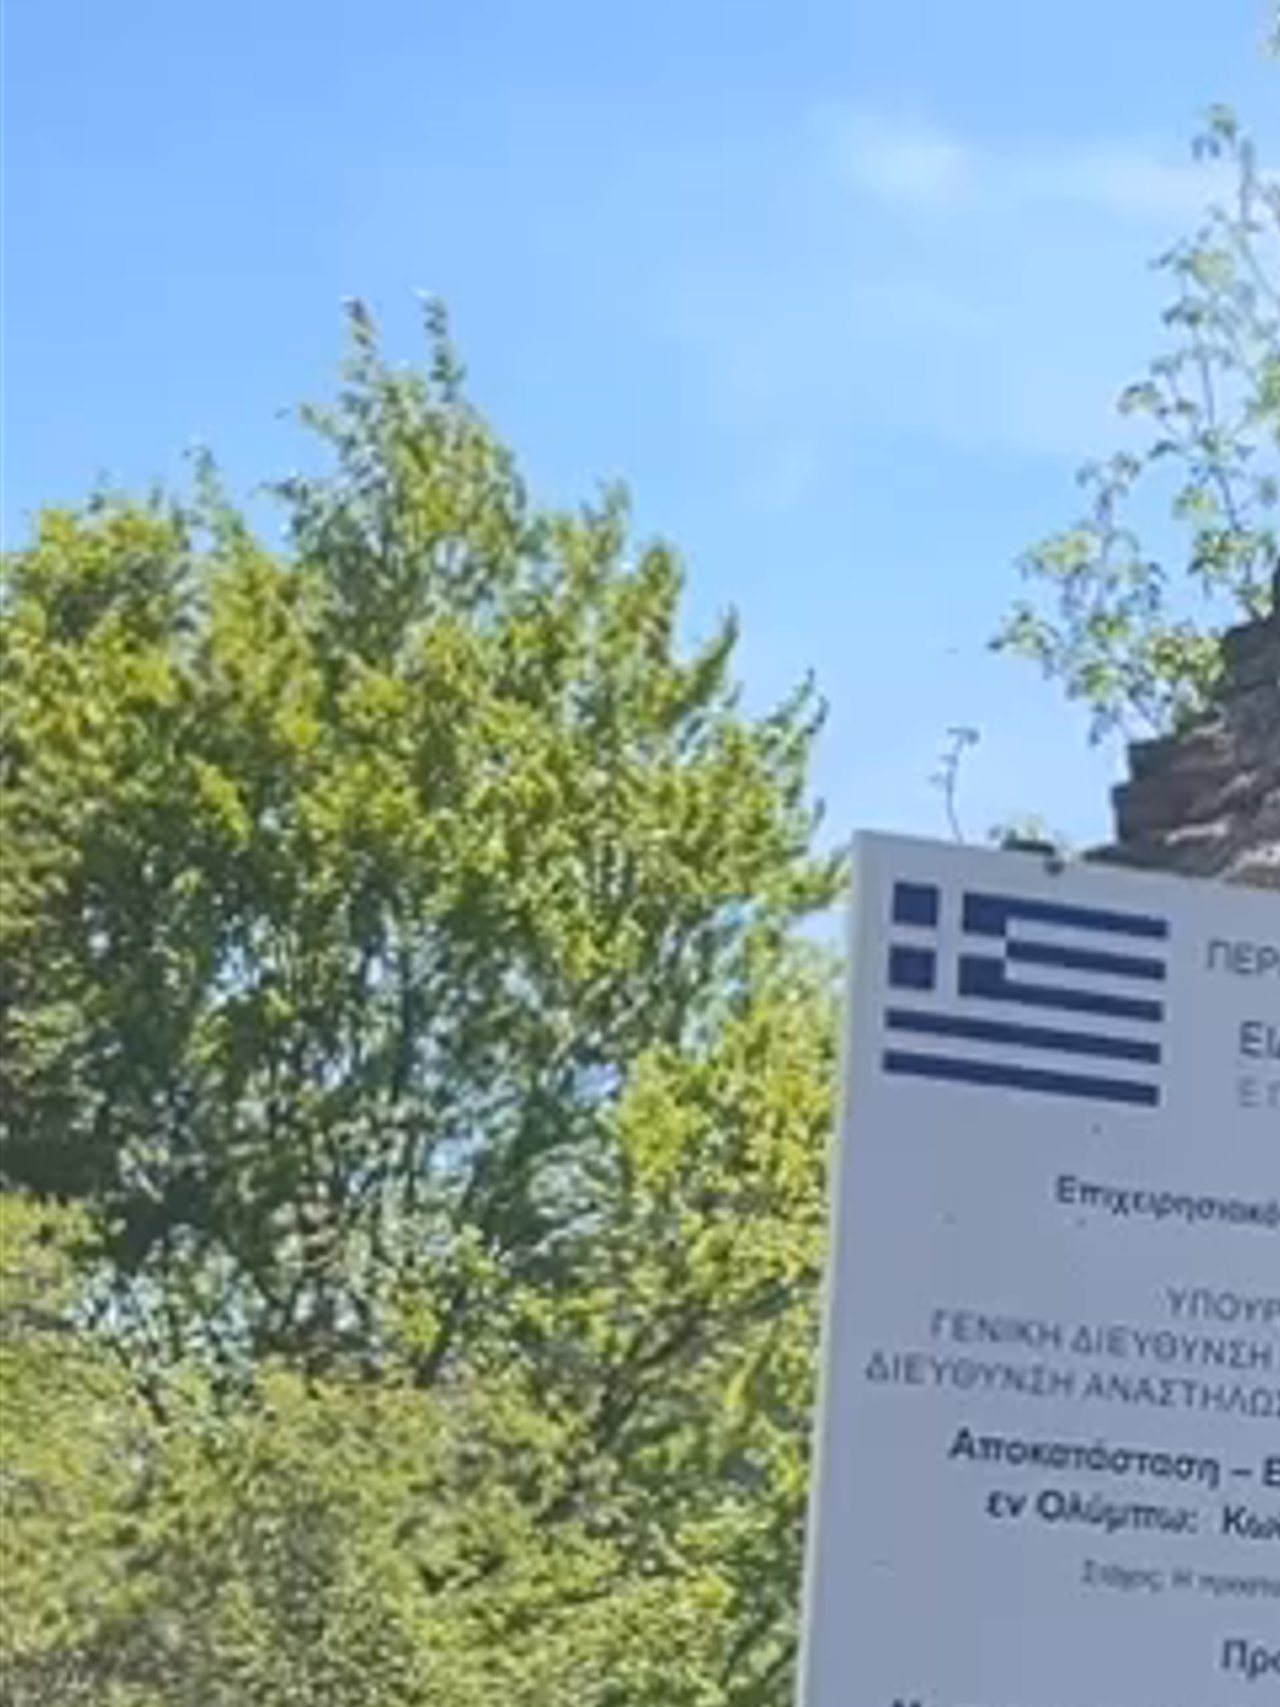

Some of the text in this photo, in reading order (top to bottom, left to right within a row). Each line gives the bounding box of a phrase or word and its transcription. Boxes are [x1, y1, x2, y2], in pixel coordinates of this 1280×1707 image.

[931, 1308, 1063, 1350] ΓΕΝΙΚΗ
[1071, 1324, 1272, 1371] ΔΙΕΥΘΥΝΣΗ
[865, 1351, 1073, 1396] ΔΙΕΥΘΥΝΣΗ
[948, 1427, 1220, 1488] Αποκατάσταση
[986, 1490, 1028, 1521] εν
